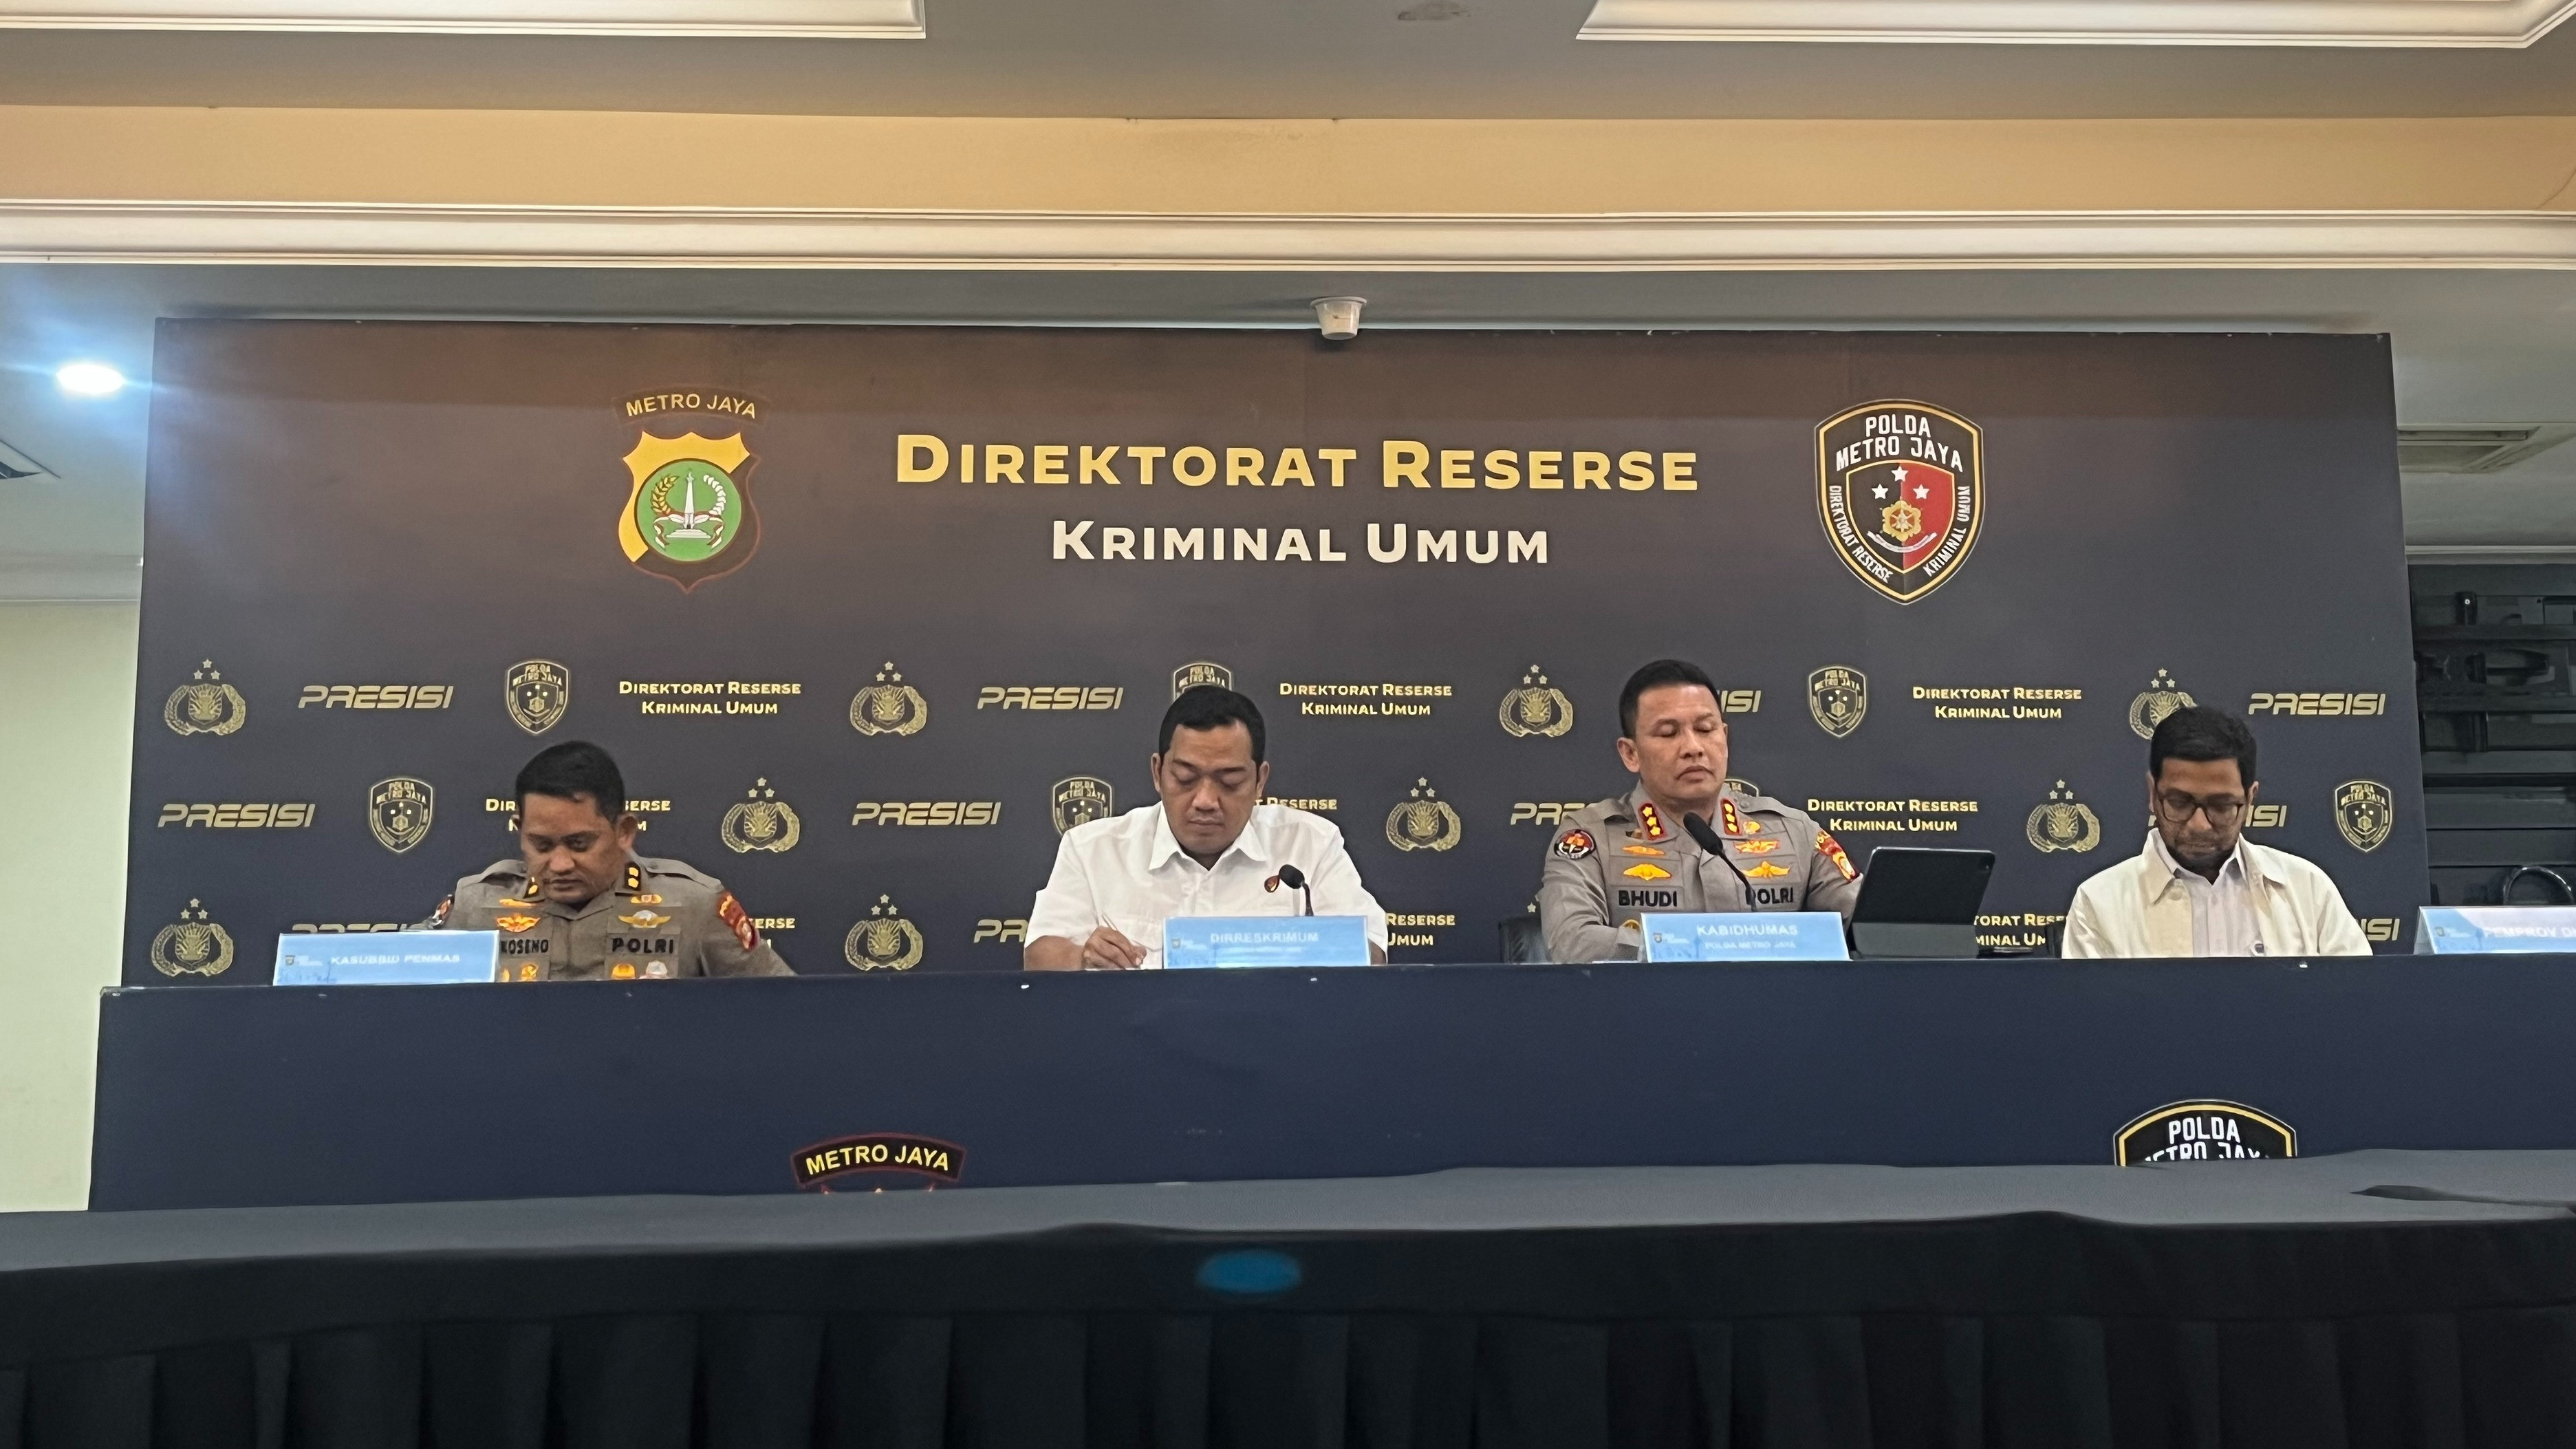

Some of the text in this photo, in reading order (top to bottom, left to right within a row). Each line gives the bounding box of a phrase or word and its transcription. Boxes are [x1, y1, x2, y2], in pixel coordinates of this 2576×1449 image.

[626, 393, 755, 419] METRO JAYA
[1865, 414, 1931, 438] POLDA
[896, 433, 1699, 492] DIREKTORAT RESERSE
[1836, 436, 1963, 473] METRO JAYA
[1829, 485, 1894, 583] DIREKTORAT RESERSE
[1923, 486, 1970, 577] KRIMINAL UMUM
[1052, 520, 1548, 565] KRIMINAL UMUM
[618, 681, 801, 694] DIREKTORAT RESERSE
[1279, 683, 1453, 696] DIREKTORAT RESERSE
[1913, 687, 2082, 700] DIREKTORAT RESERSE
[298, 685, 454, 709] PRESISI
[977, 687, 1124, 709] PRESISI
[2248, 693, 2386, 716] PRESISI
[642, 701, 778, 714] KRIMINAL UMUM
[1301, 702, 1431, 716] KRIMINAL UMUM
[1934, 705, 2062, 719] KRIMINAL UMUM
[625, 800, 671, 811] ERSE
[852, 802, 1002, 826] PRESISI
[1808, 799, 1978, 813] DIREKTORAT RESERSE
[158, 804, 316, 828] PRESISI
[1830, 818, 1958, 832] KRIMINAL UMUM
[1618, 890, 1678, 908] BHUDI
[748, 918, 796, 929] ERSE
[1385, 912, 1455, 926] RESERSE
[1696, 925, 1799, 936] KABIDHUMAS
[612, 938, 674, 954] POLRI
[1976, 934, 2021, 946] MINAL
[2169, 1116, 2240, 1145] POLDA
[805, 1144, 949, 1175] METRO JAYA
